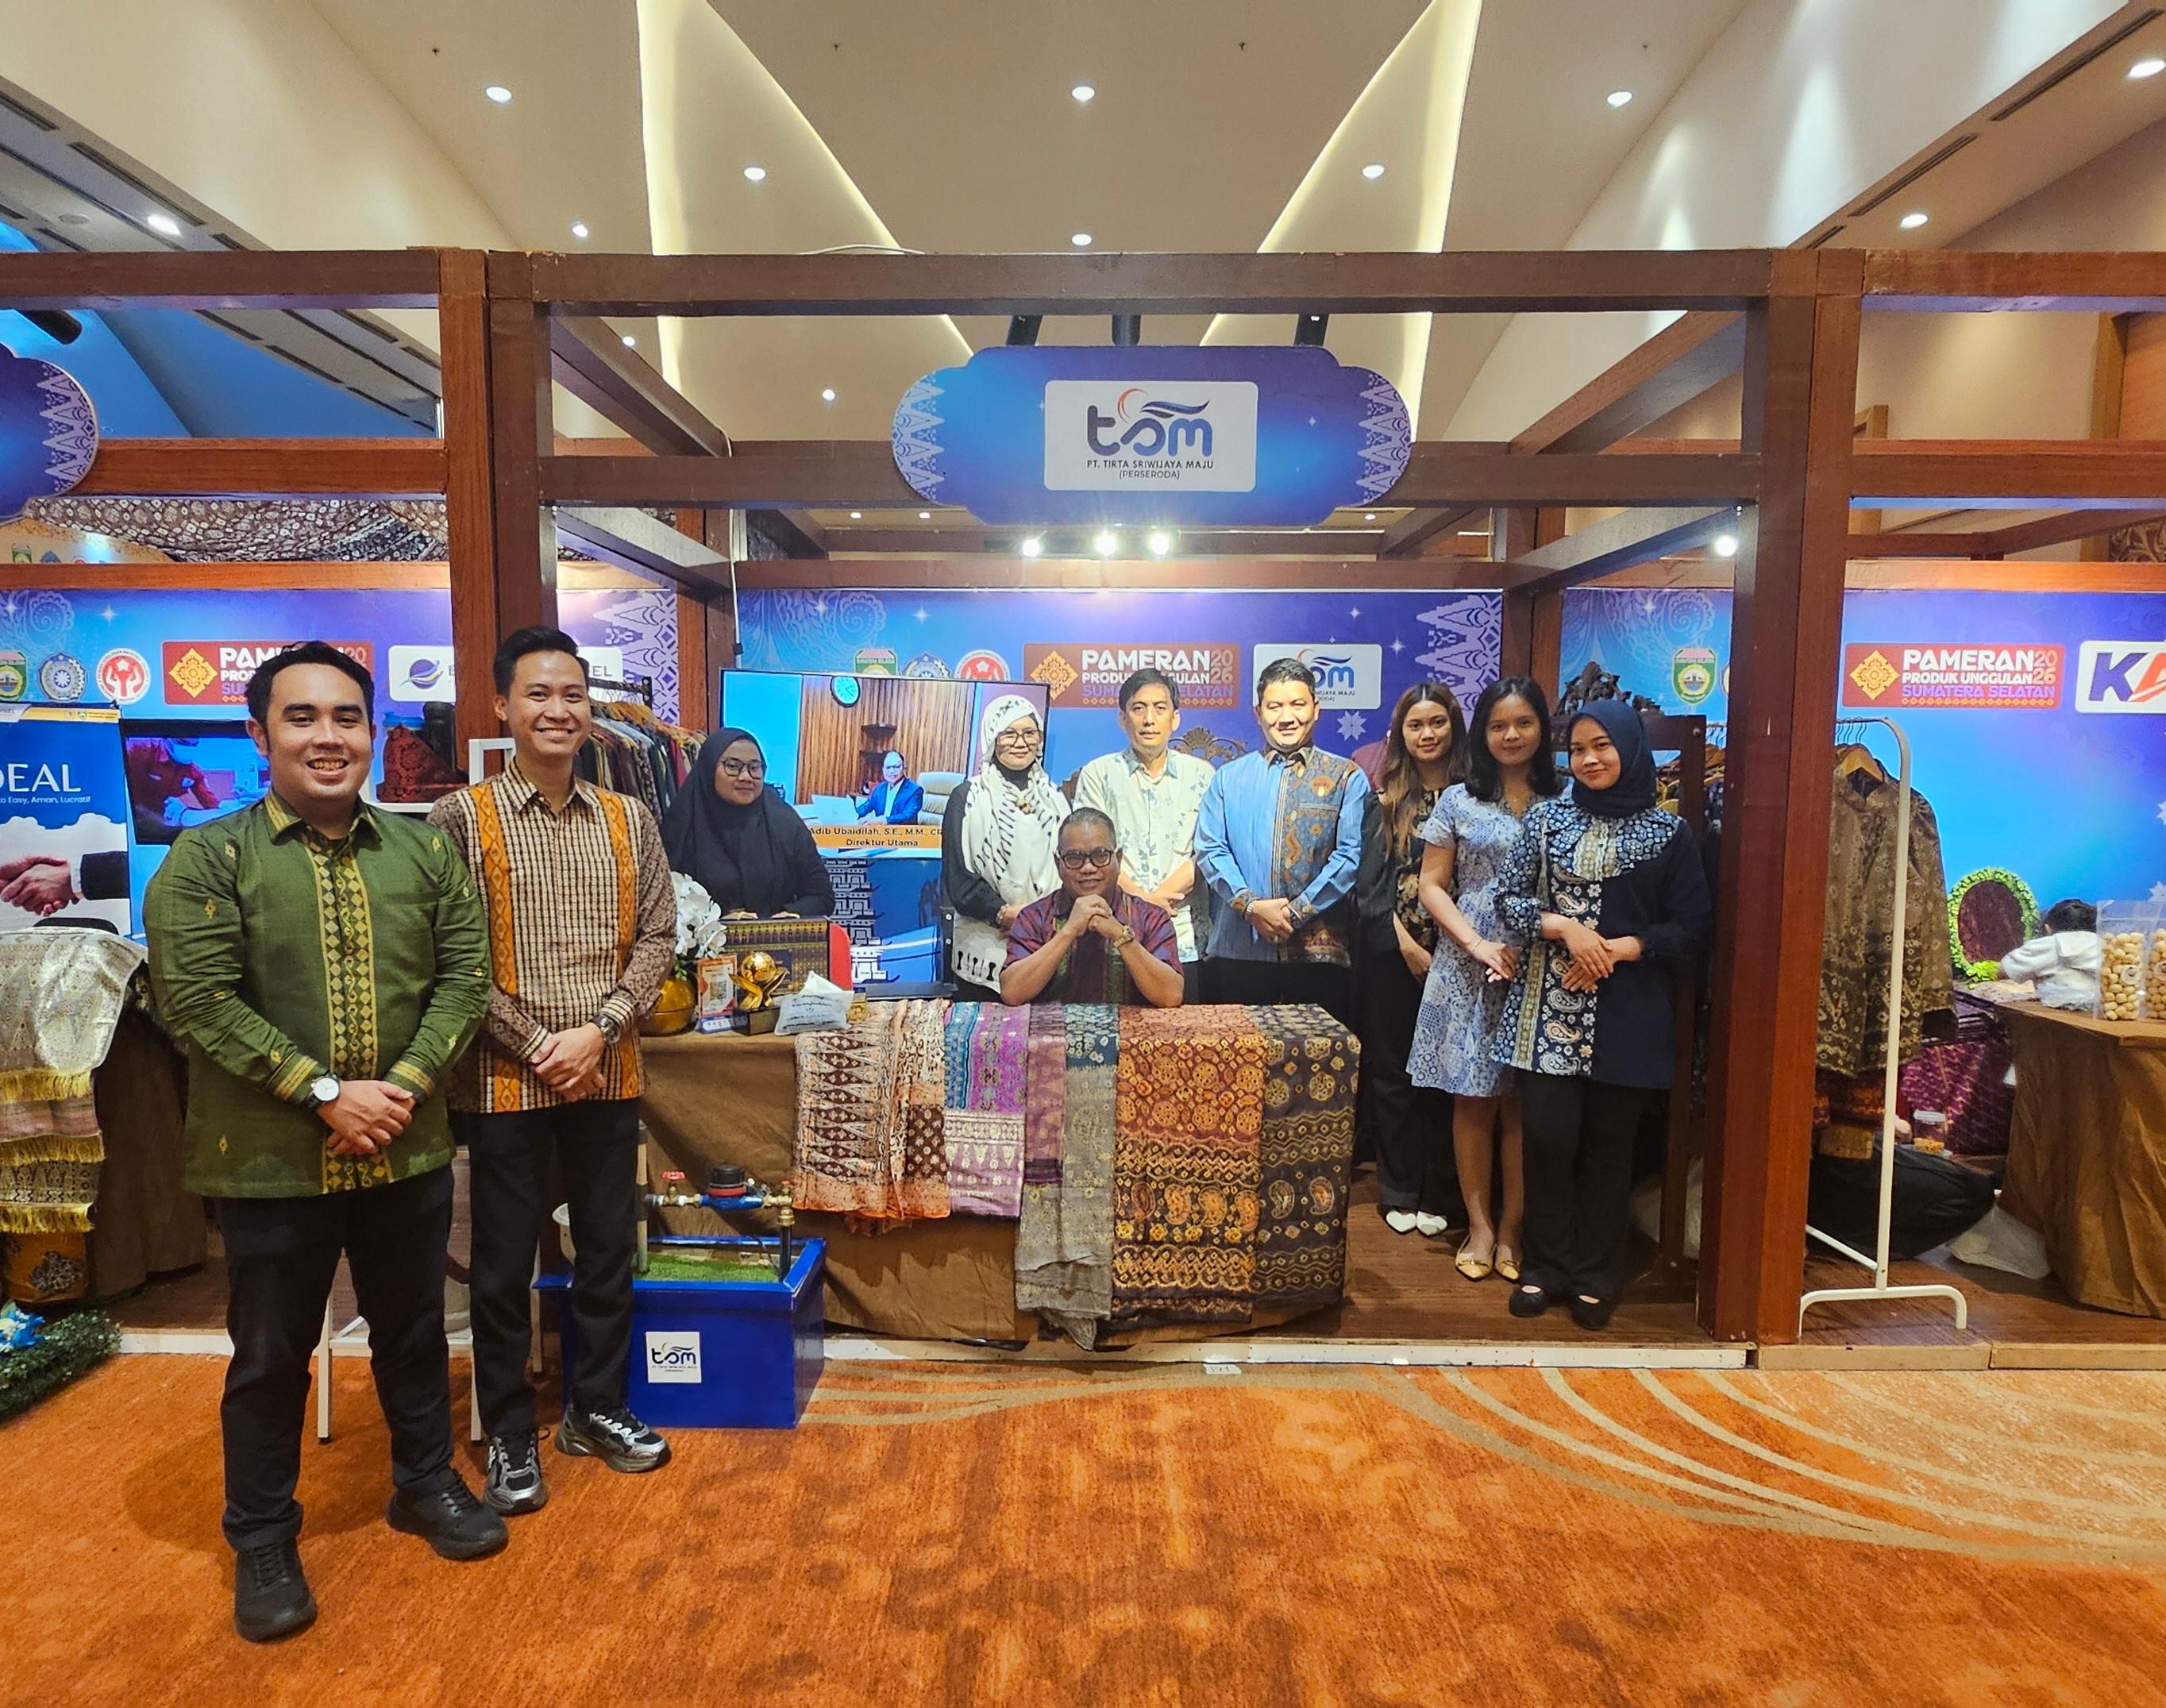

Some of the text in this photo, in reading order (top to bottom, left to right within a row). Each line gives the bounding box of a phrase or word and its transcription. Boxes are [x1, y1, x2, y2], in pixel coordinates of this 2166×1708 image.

[1119, 470, 1180, 480] (PERSERODA)
[1082, 650, 1210, 672] PAMERAN
[1211, 650, 1234, 667] 20
[1902, 649, 2034, 672] PAMERAN
[2034, 650, 2058, 668] 20
[1082, 673, 1129, 684] PRODU
[1211, 666, 1234, 684] 26
[1902, 672, 2033, 684] PRODUK UNGGULAN
[2033, 667, 2057, 684] 26
[1179, 685, 1233, 697] ELATAN
[1902, 685, 2055, 698] SUMATERA SELATAN
[0, 763, 81, 792] EAL
[834, 827, 881, 836] Ubaidilah,
